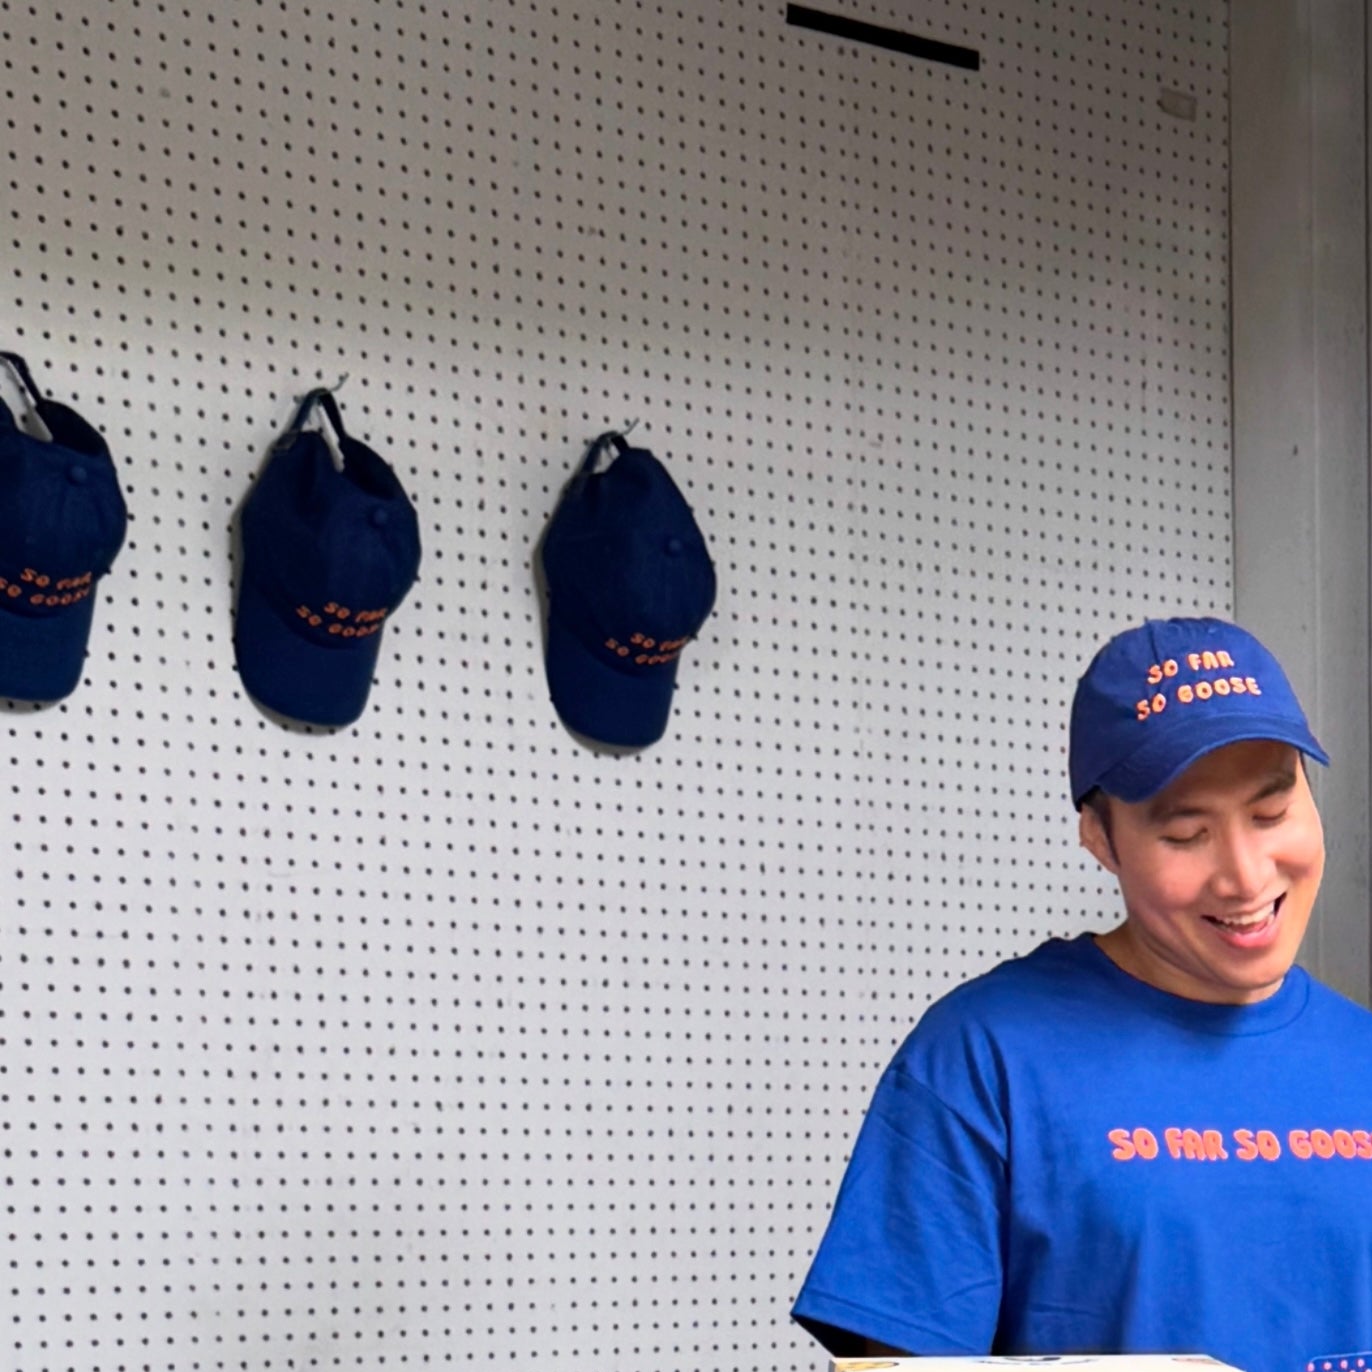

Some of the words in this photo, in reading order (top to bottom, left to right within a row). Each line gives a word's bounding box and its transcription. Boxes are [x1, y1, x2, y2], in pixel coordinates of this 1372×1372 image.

[20, 568, 50, 587] SO
[323, 602, 351, 620] SO
[630, 632, 656, 649] SO
[1147, 659, 1179, 684] SO
[1187, 650, 1235, 671] FAR
[1136, 692, 1167, 720] SO
[1177, 676, 1262, 703] GOOSE
[1108, 1128, 1159, 1160] SO
[1164, 1127, 1229, 1161] FAR
[1233, 1128, 1281, 1161] SO
